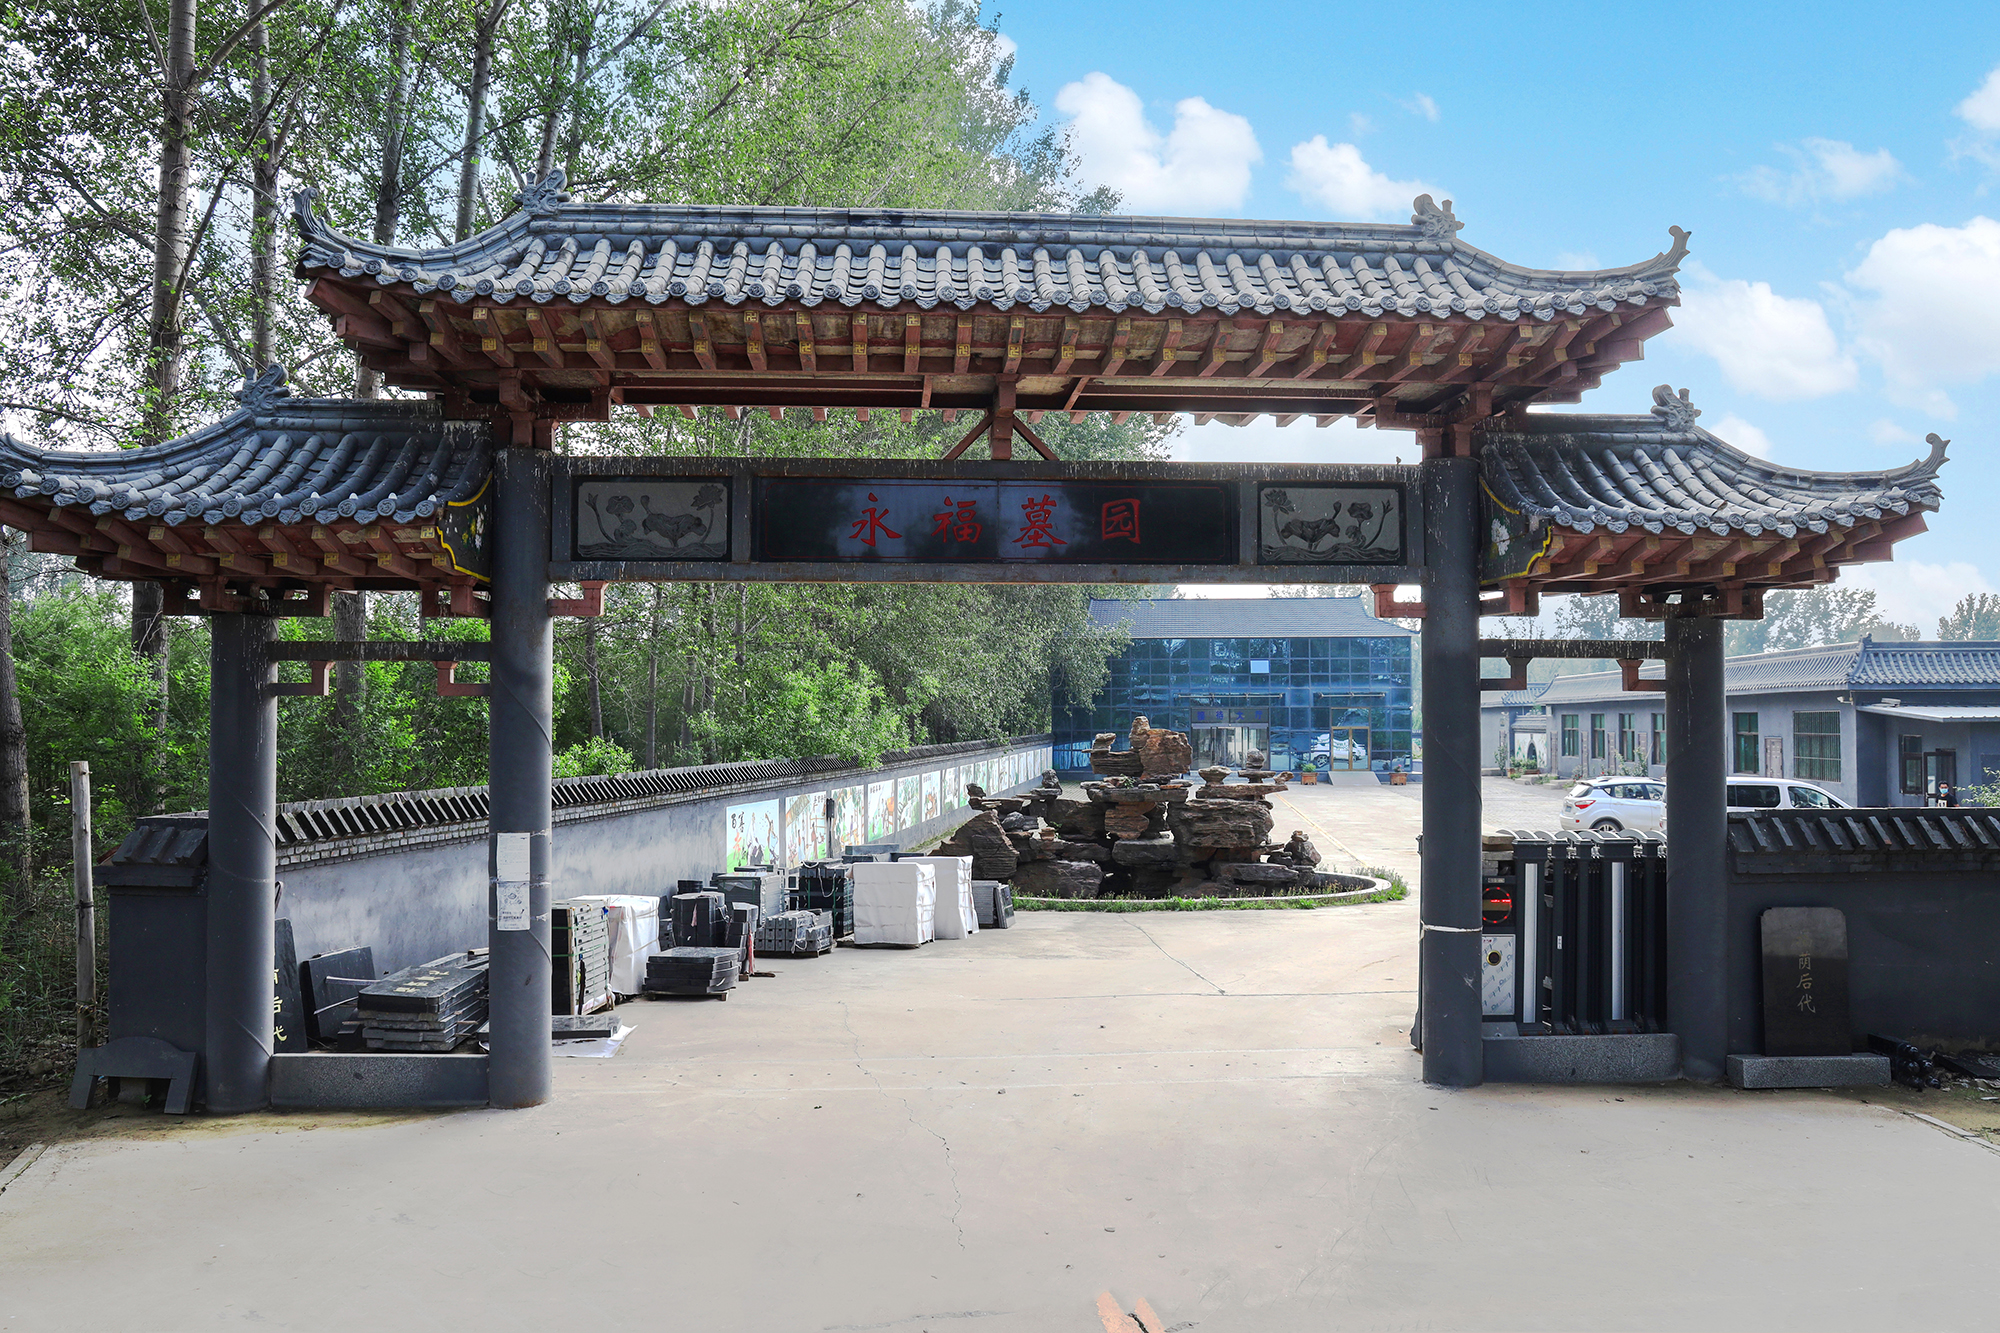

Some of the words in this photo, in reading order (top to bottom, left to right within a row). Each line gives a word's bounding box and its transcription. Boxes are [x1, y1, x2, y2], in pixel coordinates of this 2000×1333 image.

[849, 491, 1142, 549] 永福墓园
[1795, 931, 1816, 1013] 荫后代
